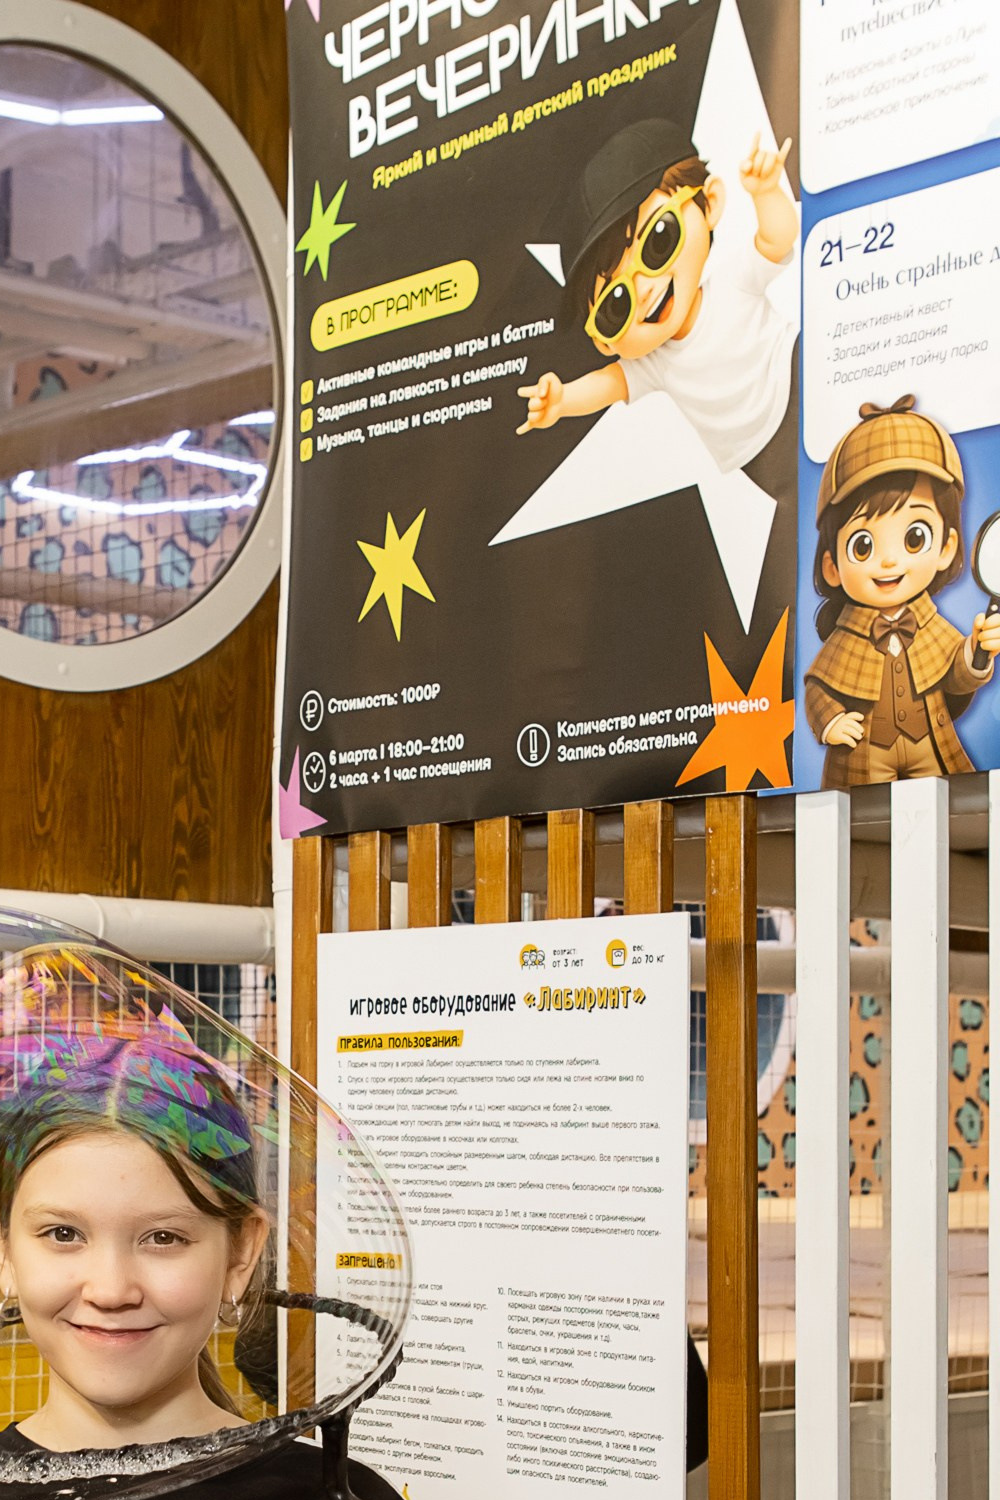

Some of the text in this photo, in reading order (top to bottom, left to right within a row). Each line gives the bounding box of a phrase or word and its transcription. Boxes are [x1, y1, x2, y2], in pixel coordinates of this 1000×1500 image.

[348, 0, 699, 159] ВЕЧЕРИНК
[372, 43, 676, 189] Яркий и шумный детский праздник
[836, 272, 889, 301] Очень
[896, 249, 984, 287] странные
[327, 279, 457, 335] В ПРОГРАММЕ:
[832, 298, 952, 340] Детективный квест
[317, 318, 554, 394] Активные командные игры и баттлы
[832, 324, 948, 362] Загадки и задания
[833, 340, 988, 385] Расследуем тайну парка
[317, 356, 527, 422] Задания на ловкость и смекалку
[317, 396, 492, 452] Музыка, танцы и сюрпризы
[328, 693, 398, 713] Стоимость:
[557, 697, 769, 738] Количество мест ограничено
[329, 750, 336, 765] 6
[338, 748, 378, 765] марта
[557, 731, 697, 762] Запись обязательна
[330, 772, 337, 788] 2
[338, 772, 368, 786] часа
[384, 766, 390, 782] 1
[393, 767, 417, 780] час
[420, 757, 491, 778] посещения
[564, 958, 569, 967] 3
[571, 959, 584, 967] лет
[632, 955, 642, 965] до
[645, 954, 654, 963] 70
